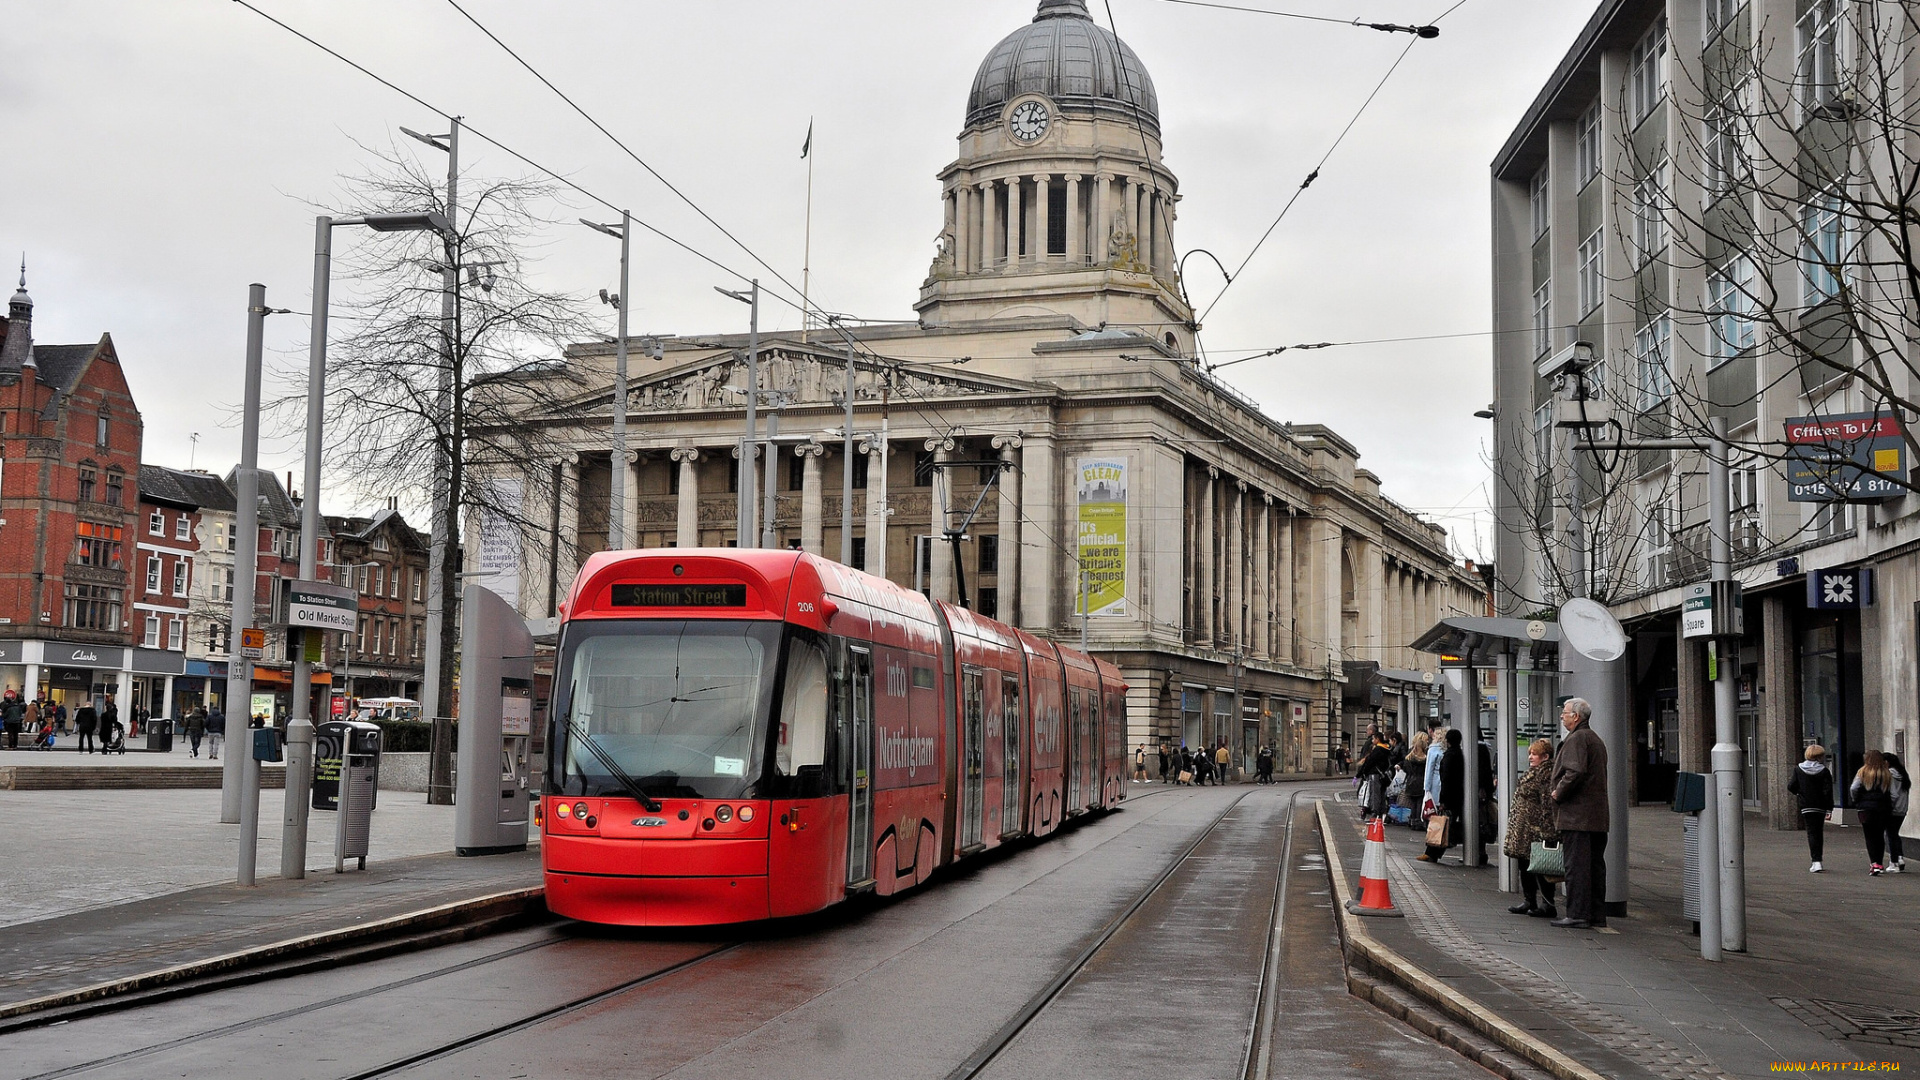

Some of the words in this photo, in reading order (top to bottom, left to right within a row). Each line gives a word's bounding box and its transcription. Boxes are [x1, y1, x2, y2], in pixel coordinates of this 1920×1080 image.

[1793, 427, 1839, 437] Offices
[1843, 424, 1857, 434] To
[1875, 463, 1897, 471] savills
[1083, 467, 1121, 482] CLEAN
[1794, 484, 1827, 496] 0115
[1080, 521, 1096, 533] It's
[1080, 533, 1124, 546] official...
[1102, 548, 1119, 556] are
[1080, 559, 1121, 570] Britain's
[1080, 571, 1124, 581] Ceanest
[1080, 582, 1101, 593] Cty!
[633, 587, 680, 604] Station
[684, 587, 728, 604] Street
[797, 602, 814, 613] 206
[298, 609, 314, 621] Old
[316, 612, 340, 624] Market
[1686, 619, 1704, 632] Square
[71, 650, 98, 661] Clarks
[63, 672, 81, 680] Clarks
[886, 653, 905, 698] into
[879, 727, 934, 777] Nottingham
